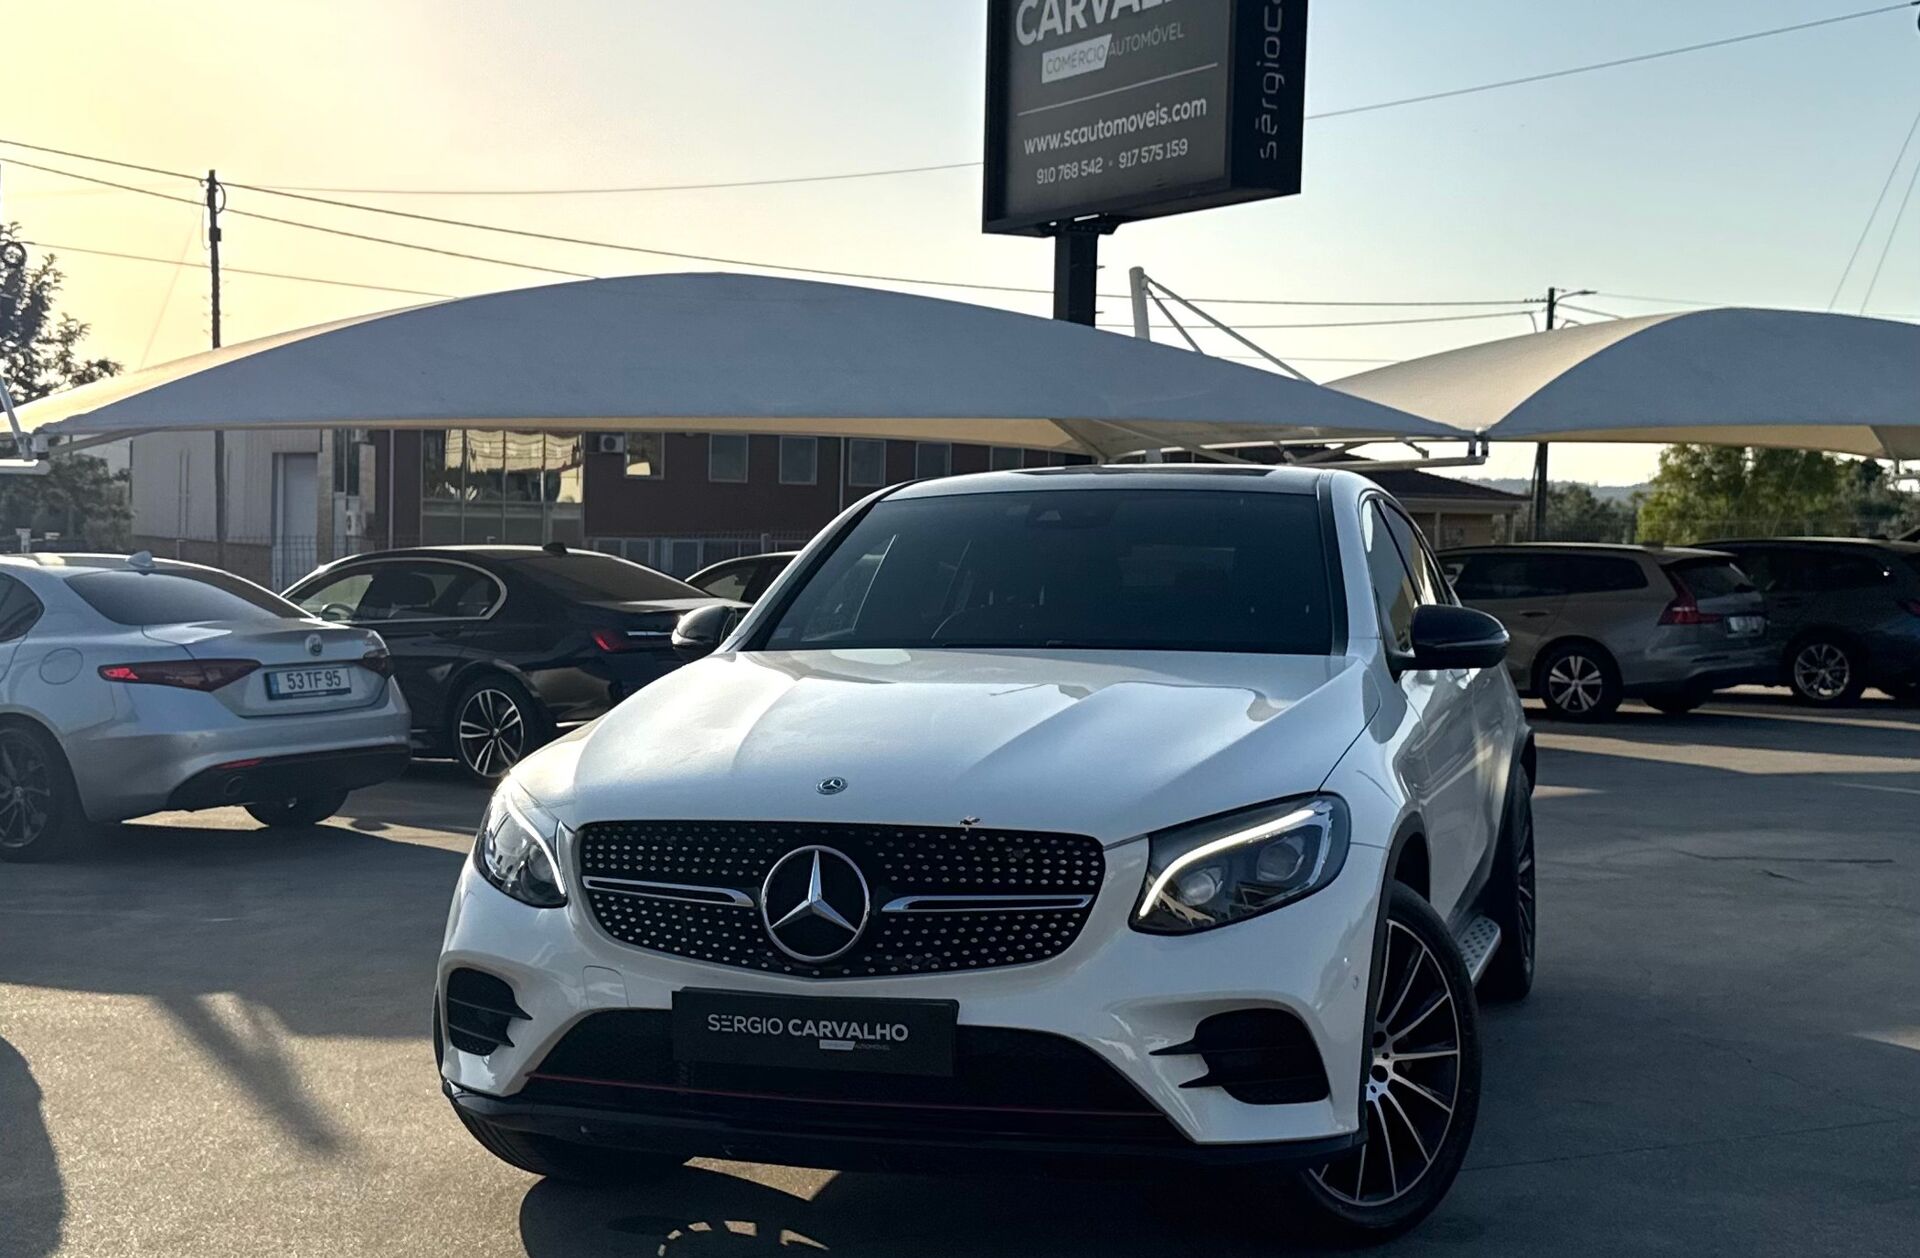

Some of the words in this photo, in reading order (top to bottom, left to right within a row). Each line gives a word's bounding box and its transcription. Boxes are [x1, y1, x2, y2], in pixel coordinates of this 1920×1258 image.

[1108, 23, 1184, 57] AUTOMÓVEL
[1024, 98, 1207, 155] www.scautomoveis.com
[1036, 167, 1056, 185] 910
[1058, 162, 1079, 181] 768
[1081, 156, 1104, 177] 542
[1118, 148, 1139, 169] 917
[1141, 143, 1163, 164] 575
[1166, 138, 1188, 159] 159
[788, 1018, 909, 1042] CARVALHO
